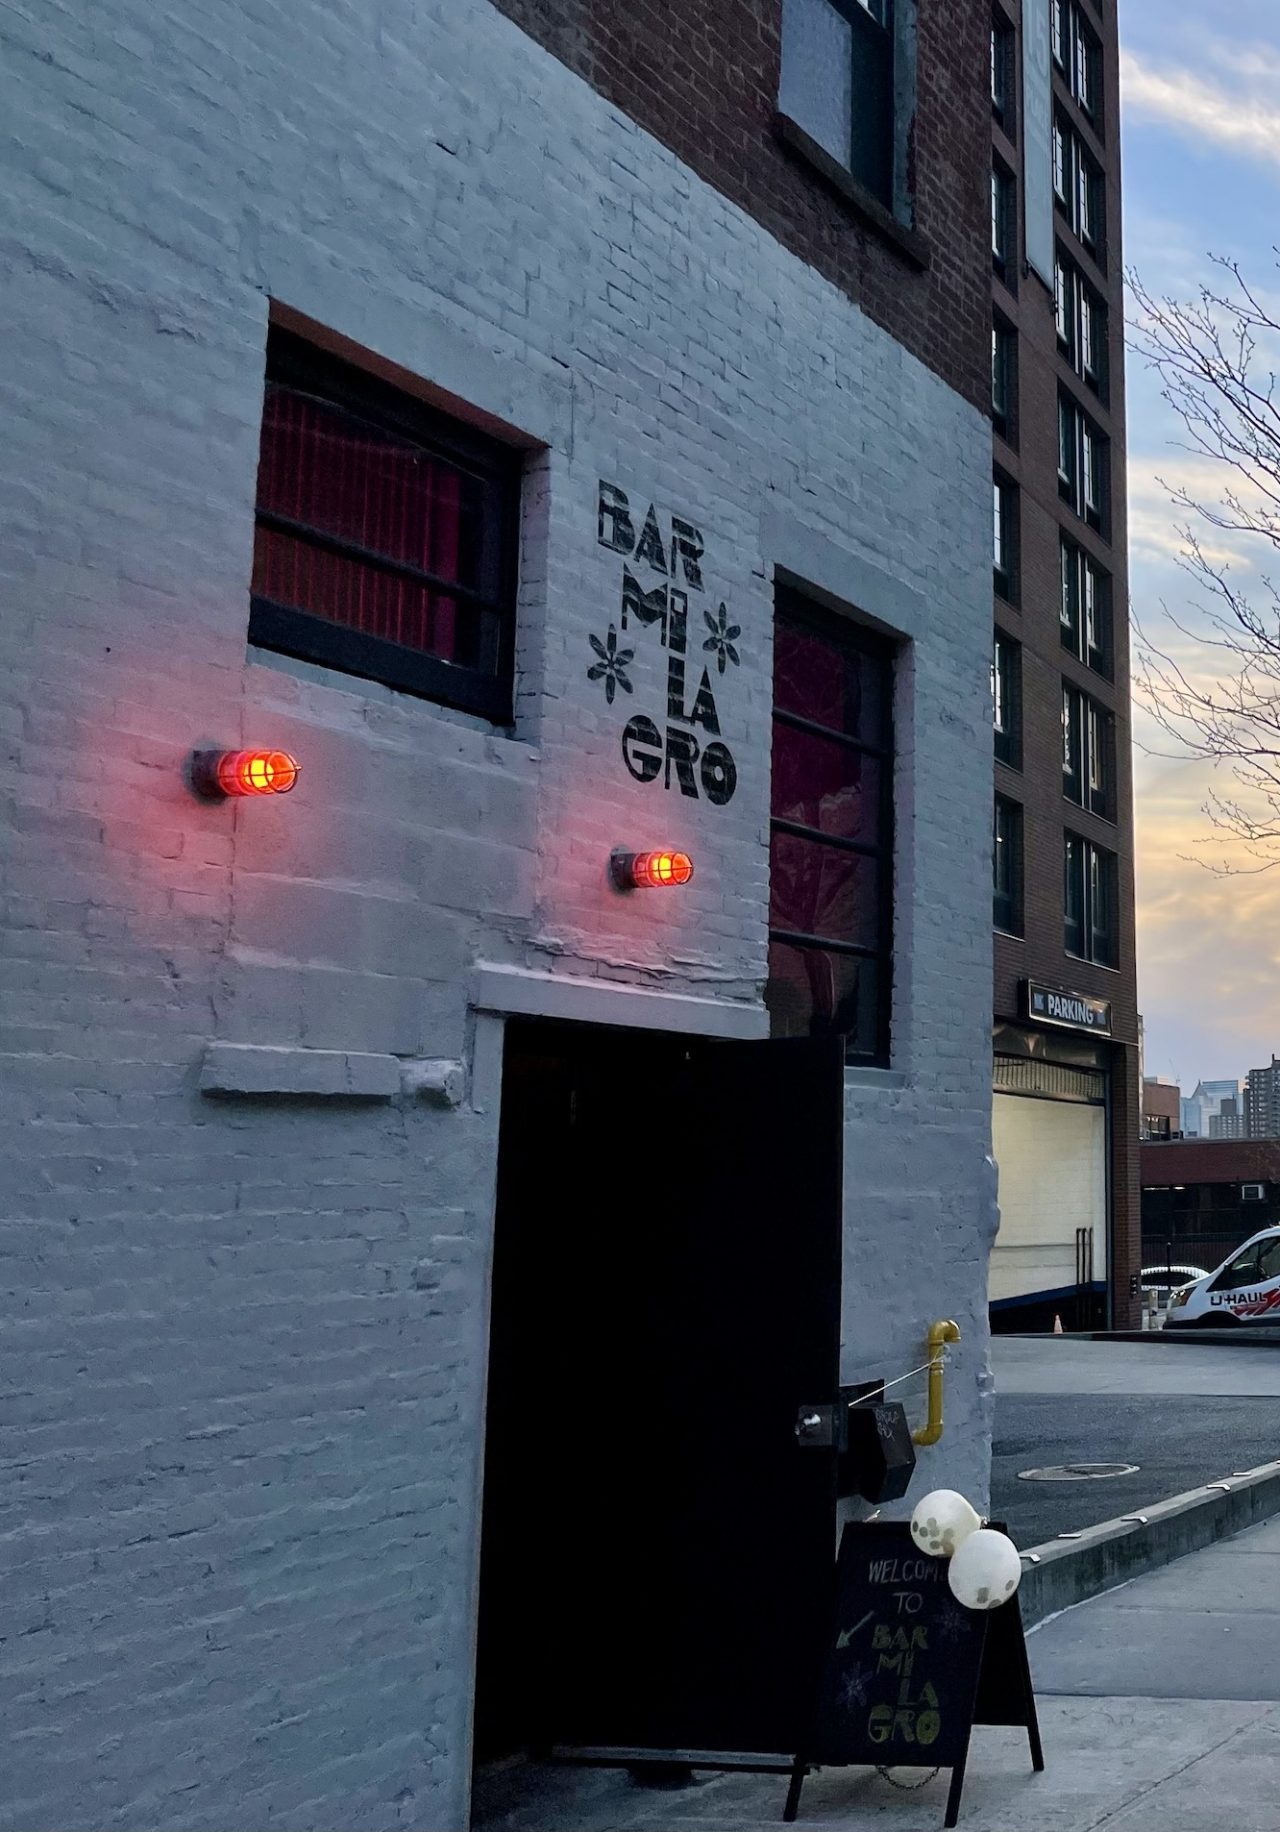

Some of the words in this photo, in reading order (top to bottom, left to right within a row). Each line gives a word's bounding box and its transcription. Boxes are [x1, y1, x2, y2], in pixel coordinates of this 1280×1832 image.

[597, 478, 705, 593] BAR
[621, 714, 737, 805] GRO
[1047, 994, 1094, 1024] PARKING
[1210, 1292, 1267, 1306] U-HAUL
[892, 1592, 924, 1614] TO
[871, 1624, 929, 1650] BAR
[867, 1704, 941, 1745] GRO
